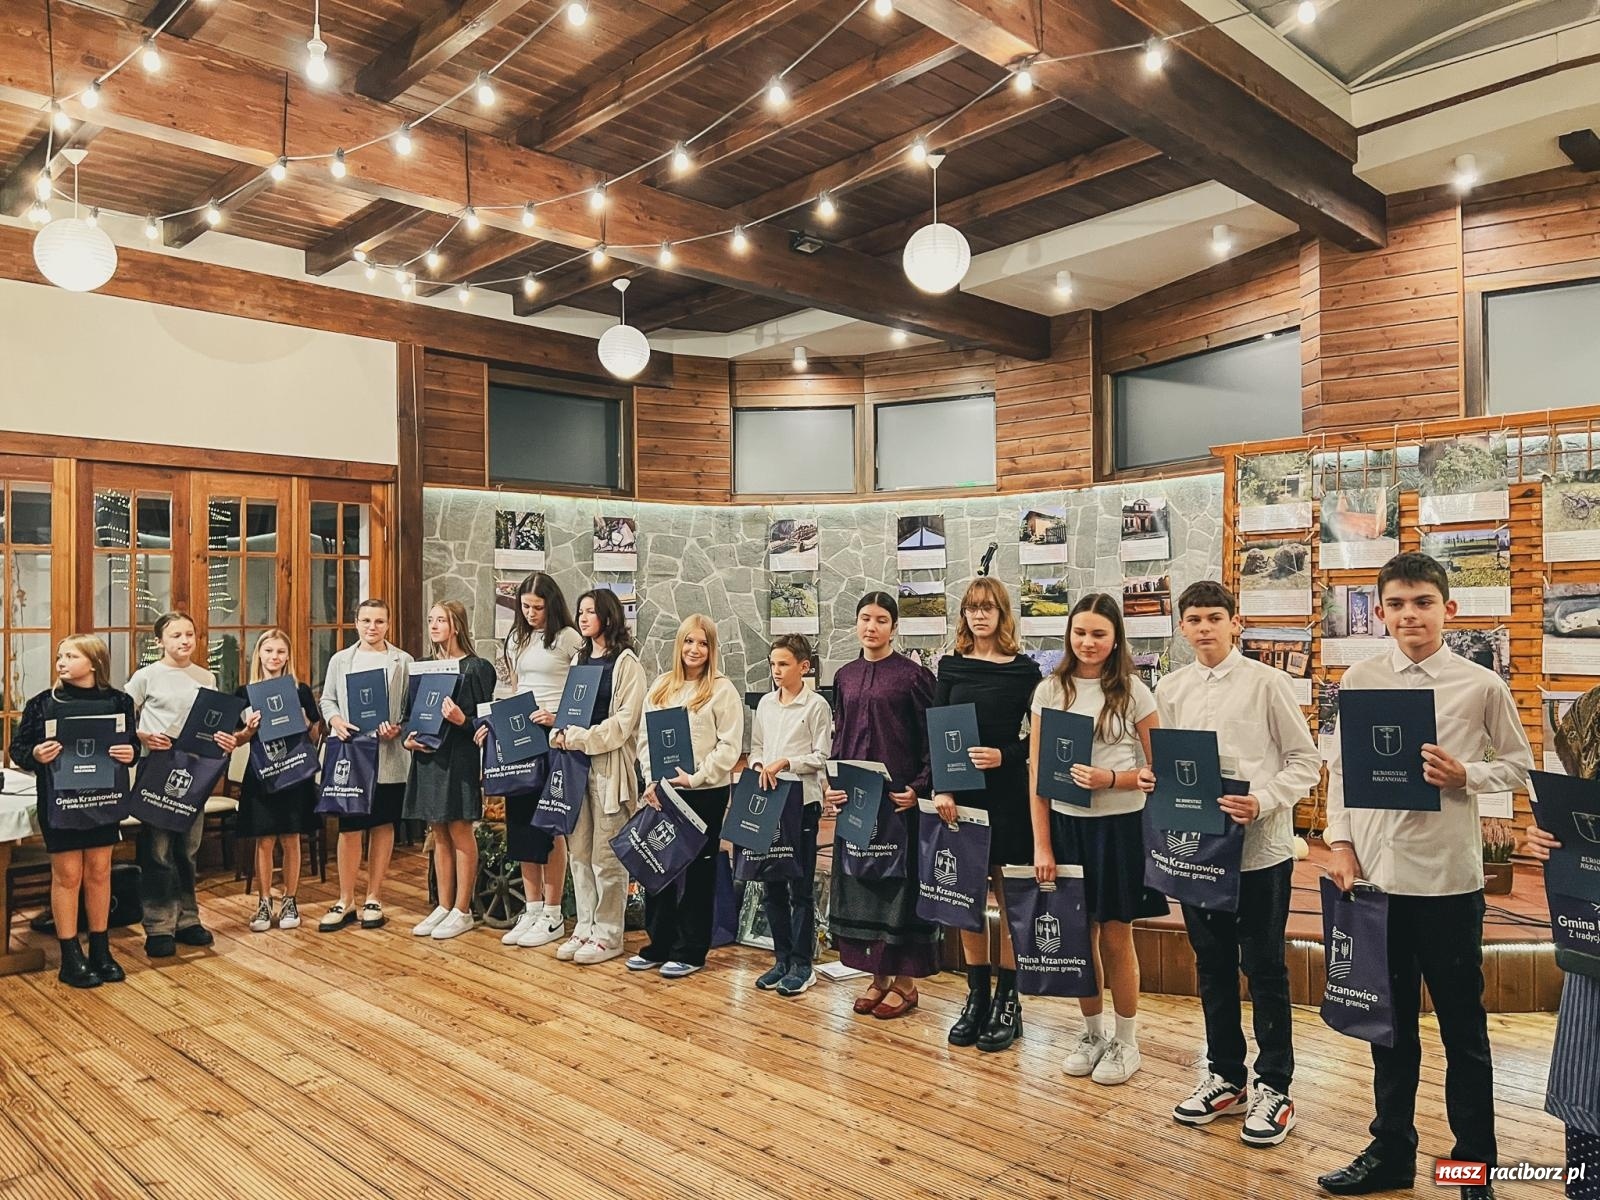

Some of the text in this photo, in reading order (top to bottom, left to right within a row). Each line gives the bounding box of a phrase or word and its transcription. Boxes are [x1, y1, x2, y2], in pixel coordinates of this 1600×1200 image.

[55, 792, 123, 806] Gmina Krzanowice
[640, 840, 666, 874] Krzanowice
[1151, 849, 1226, 875] Gmina Krzanowice
[936, 885, 975, 904] Krzanowice
[1558, 916, 1595, 931] Gmina
[1568, 929, 1600, 944] Z tradycj
[1041, 955, 1087, 965] Krzanowice
[1345, 999, 1370, 1011] granicę
